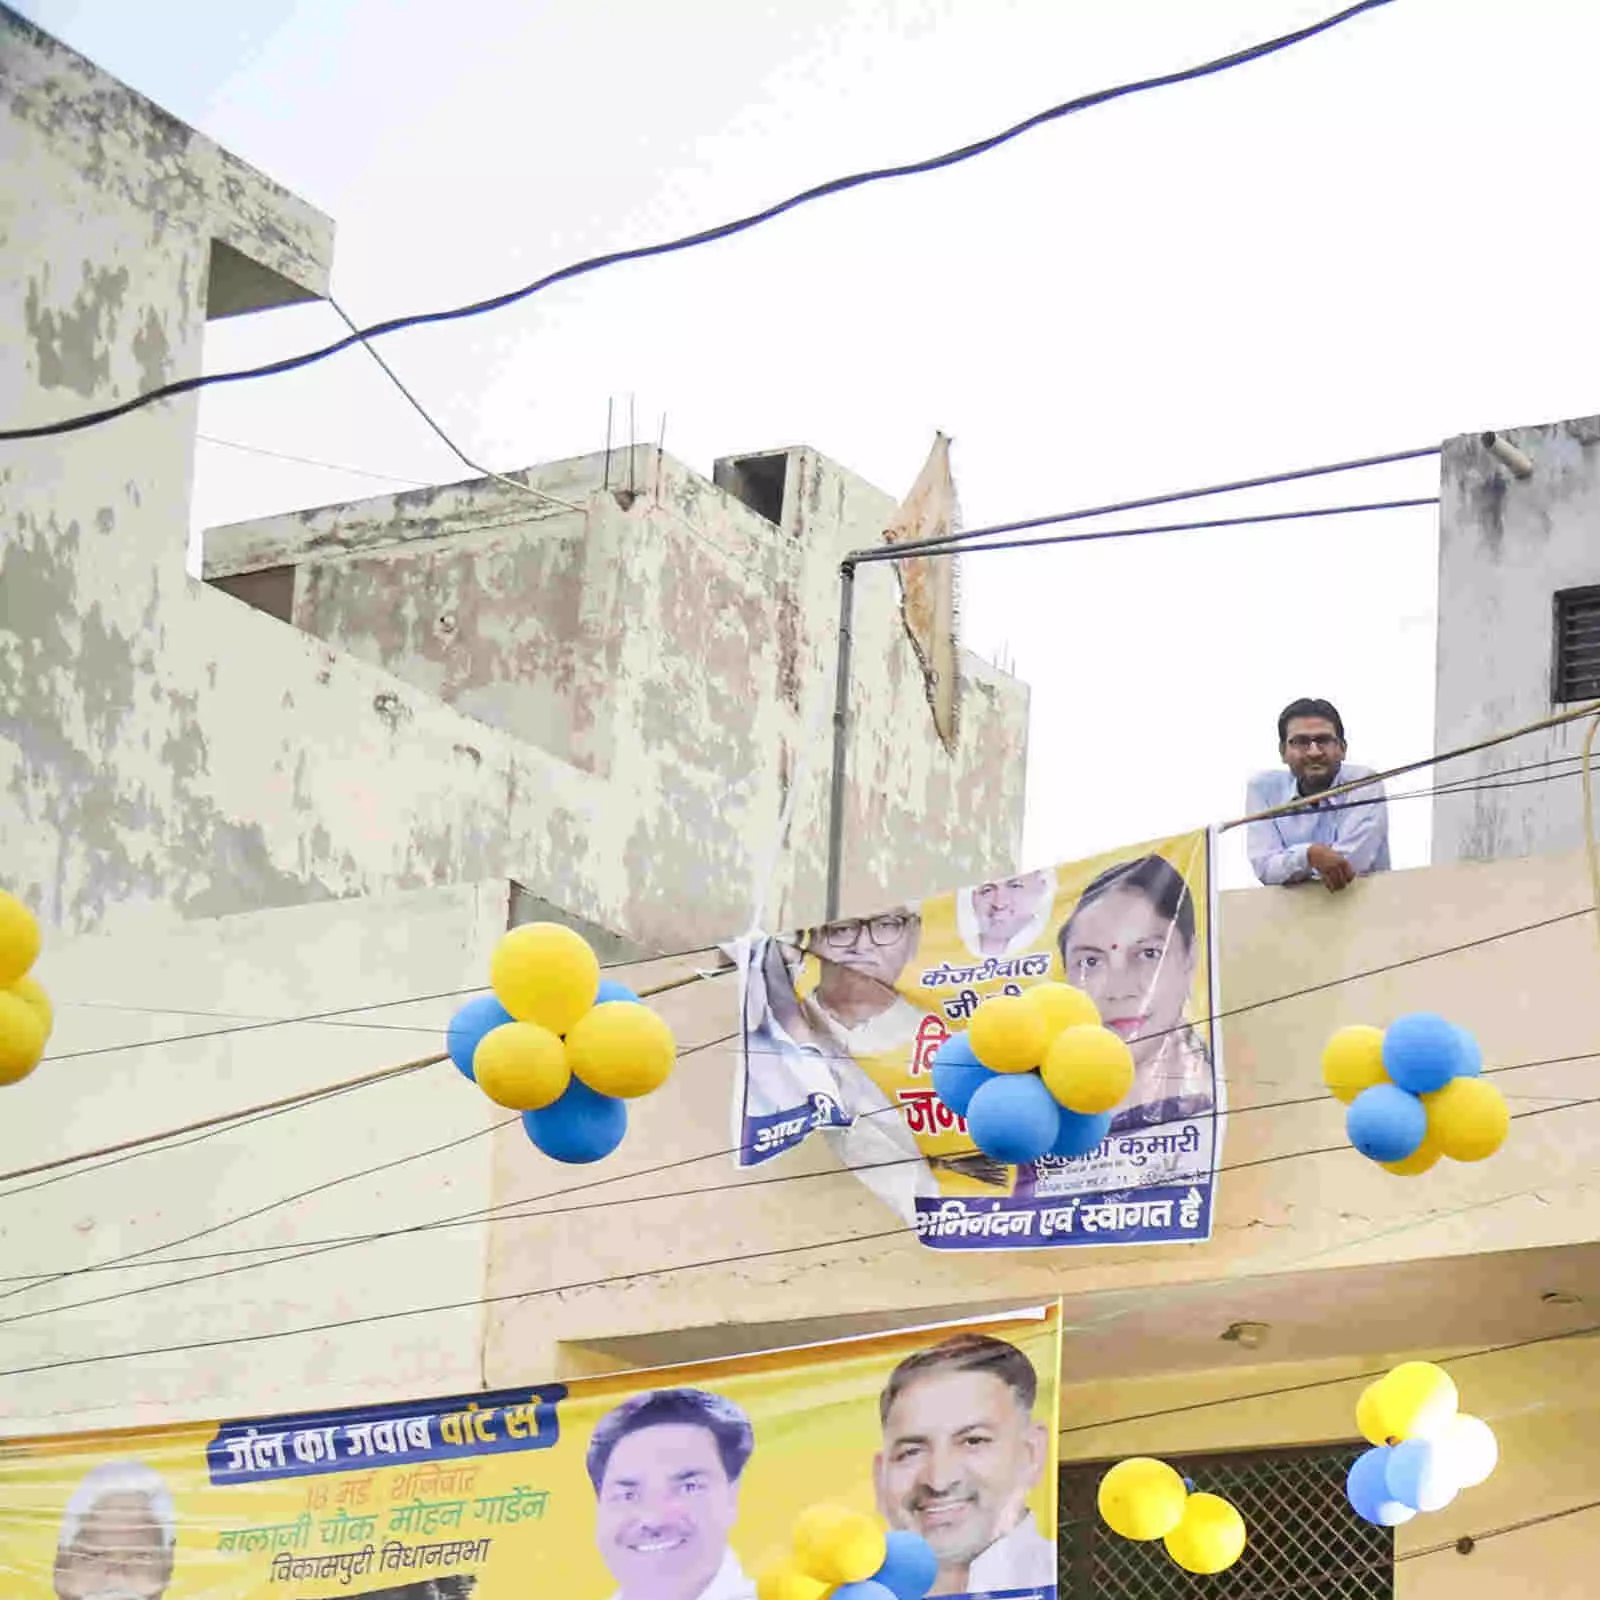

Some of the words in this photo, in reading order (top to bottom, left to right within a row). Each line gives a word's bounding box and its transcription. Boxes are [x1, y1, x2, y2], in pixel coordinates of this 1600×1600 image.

[922, 955, 1051, 987] केजरीवाल
[1117, 1125, 1200, 1165] कुमारी
[1040, 1198, 1080, 1236] एवं
[1080, 1201, 1174, 1232] स्वागत
[1179, 1186, 1203, 1229] है
[294, 1427, 338, 1463] का
[346, 1415, 437, 1457] जवाब
[217, 1512, 313, 1553] बालाजी
[388, 1498, 467, 1536] मोहन
[270, 1545, 380, 1585] विकासपुरी
[379, 1537, 494, 1574] विधानसभा
